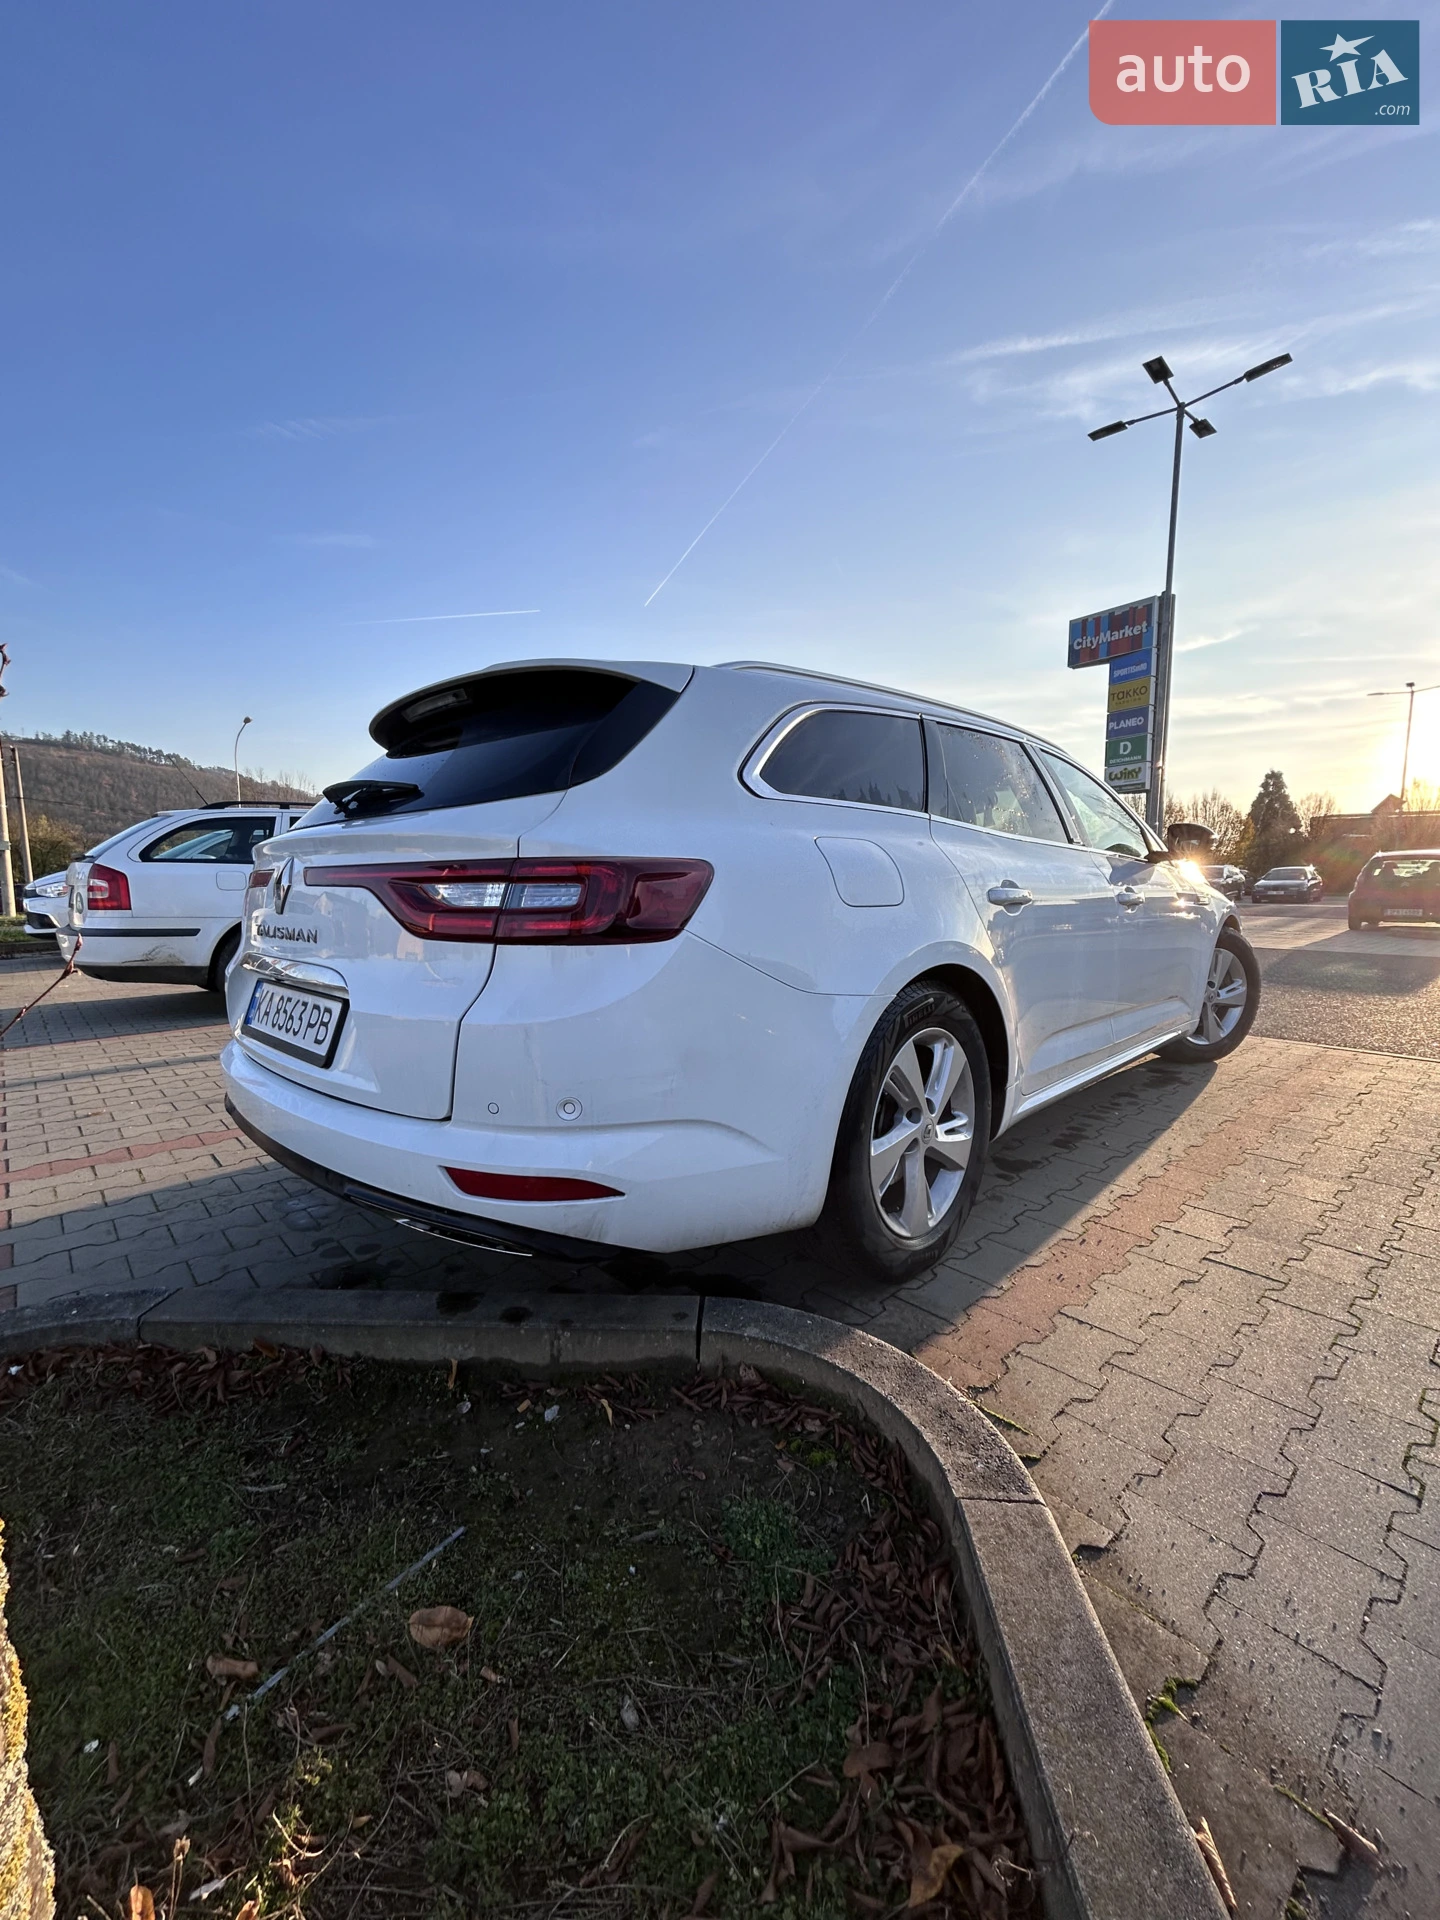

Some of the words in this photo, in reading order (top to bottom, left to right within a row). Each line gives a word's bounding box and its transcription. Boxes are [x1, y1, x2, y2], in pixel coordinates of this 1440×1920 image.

[1073, 620, 1148, 651] CityMarket
[1108, 716, 1145, 731] PLANEO
[1119, 741, 1132, 755] D
[1109, 755, 1142, 764] DEICHMANN
[255, 924, 319, 944] TALISMAN
[254, 989, 275, 1026] KA
[272, 994, 309, 1037] 8563
[303, 1003, 333, 1045] PB
